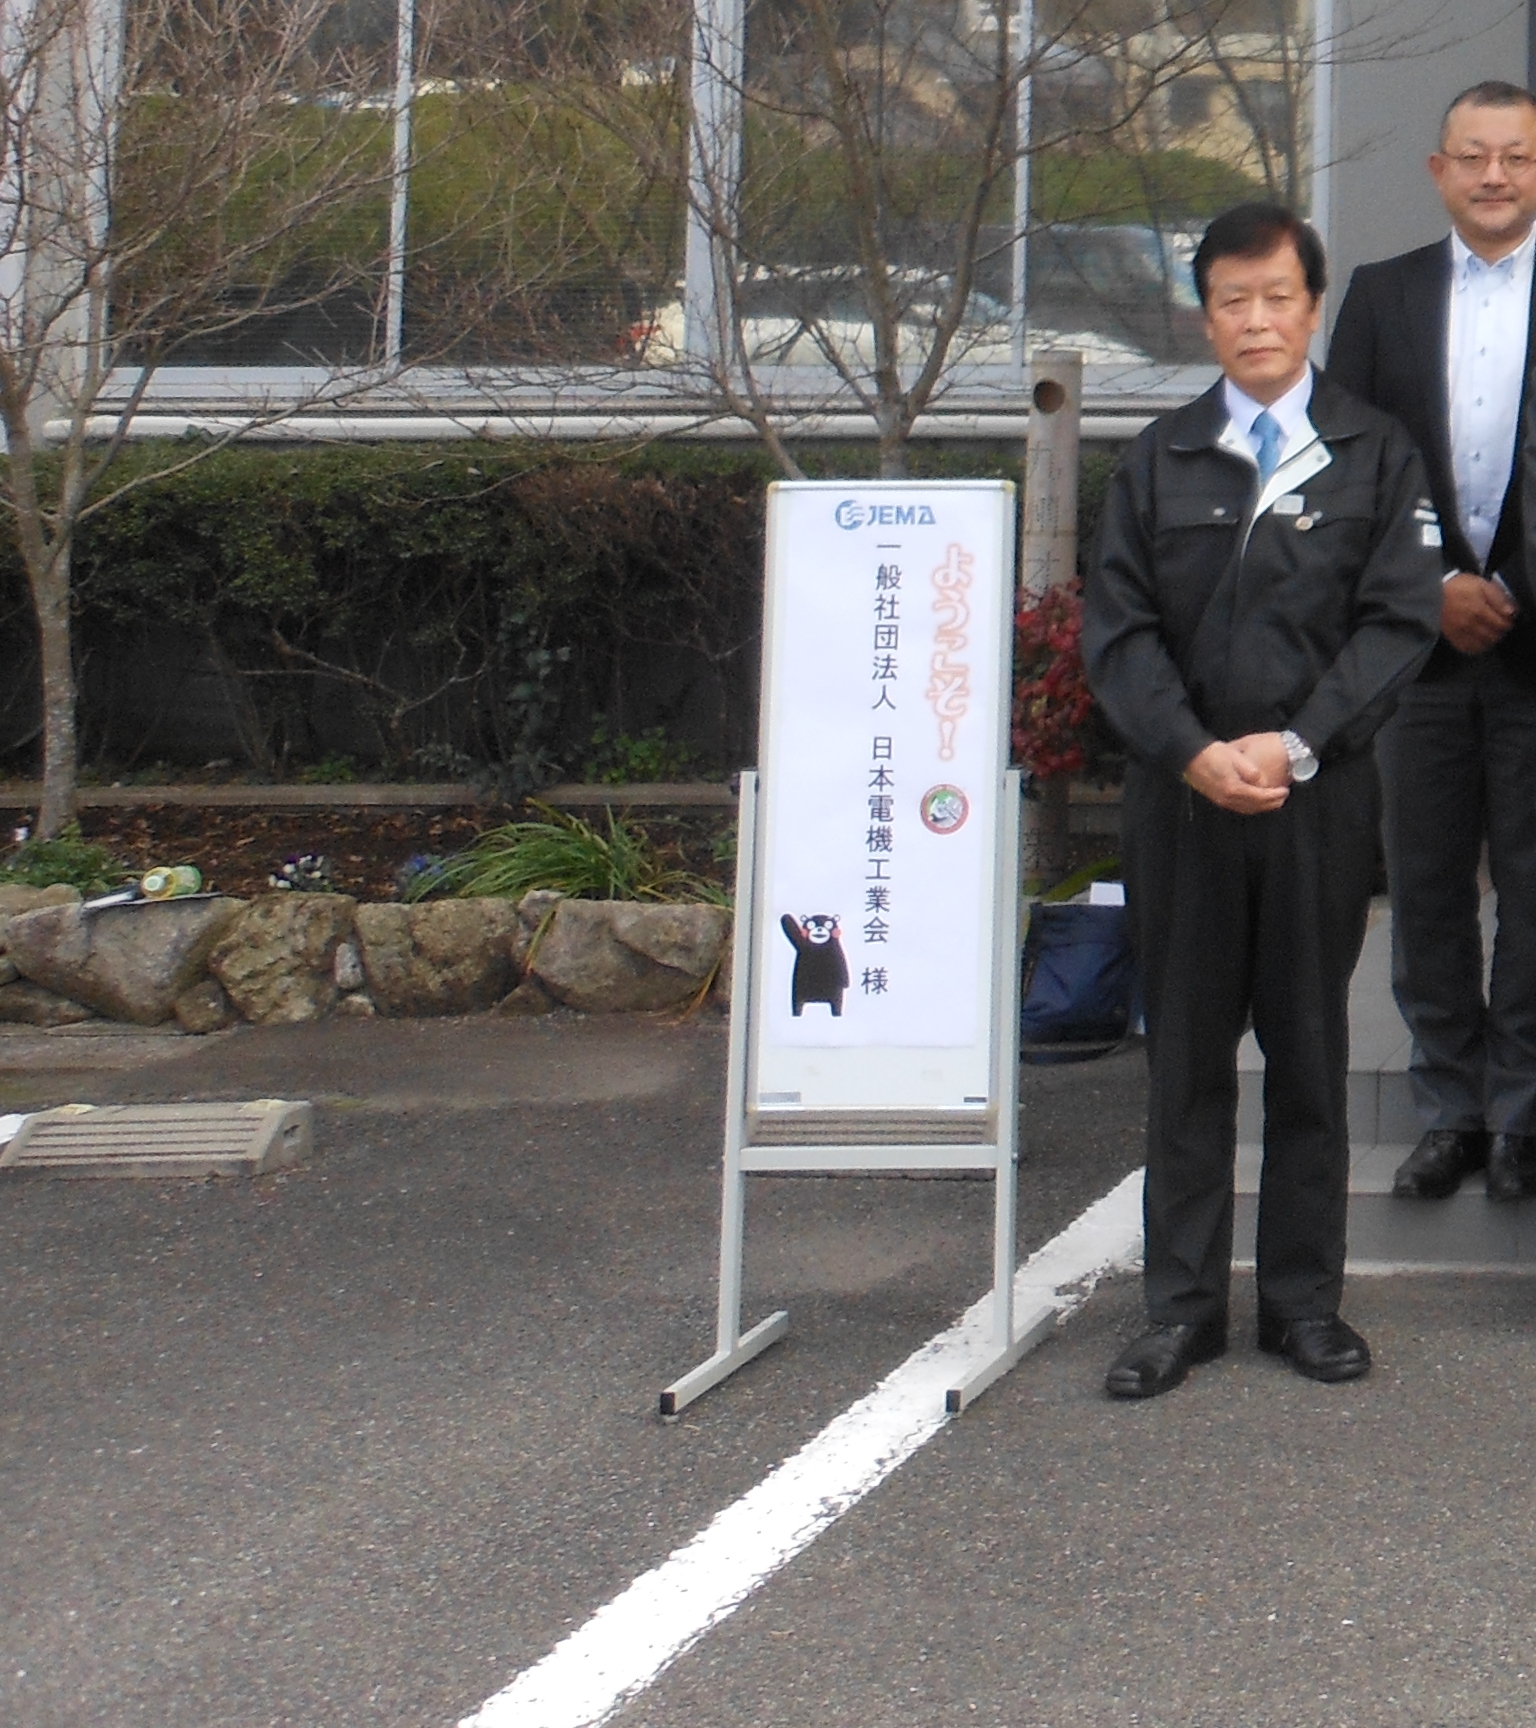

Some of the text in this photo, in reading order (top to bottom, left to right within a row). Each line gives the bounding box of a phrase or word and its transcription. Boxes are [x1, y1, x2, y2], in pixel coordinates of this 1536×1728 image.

[867, 505, 937, 527] JEMA
[861, 543, 902, 995] 一般社団法人 日本電機工業会 様
